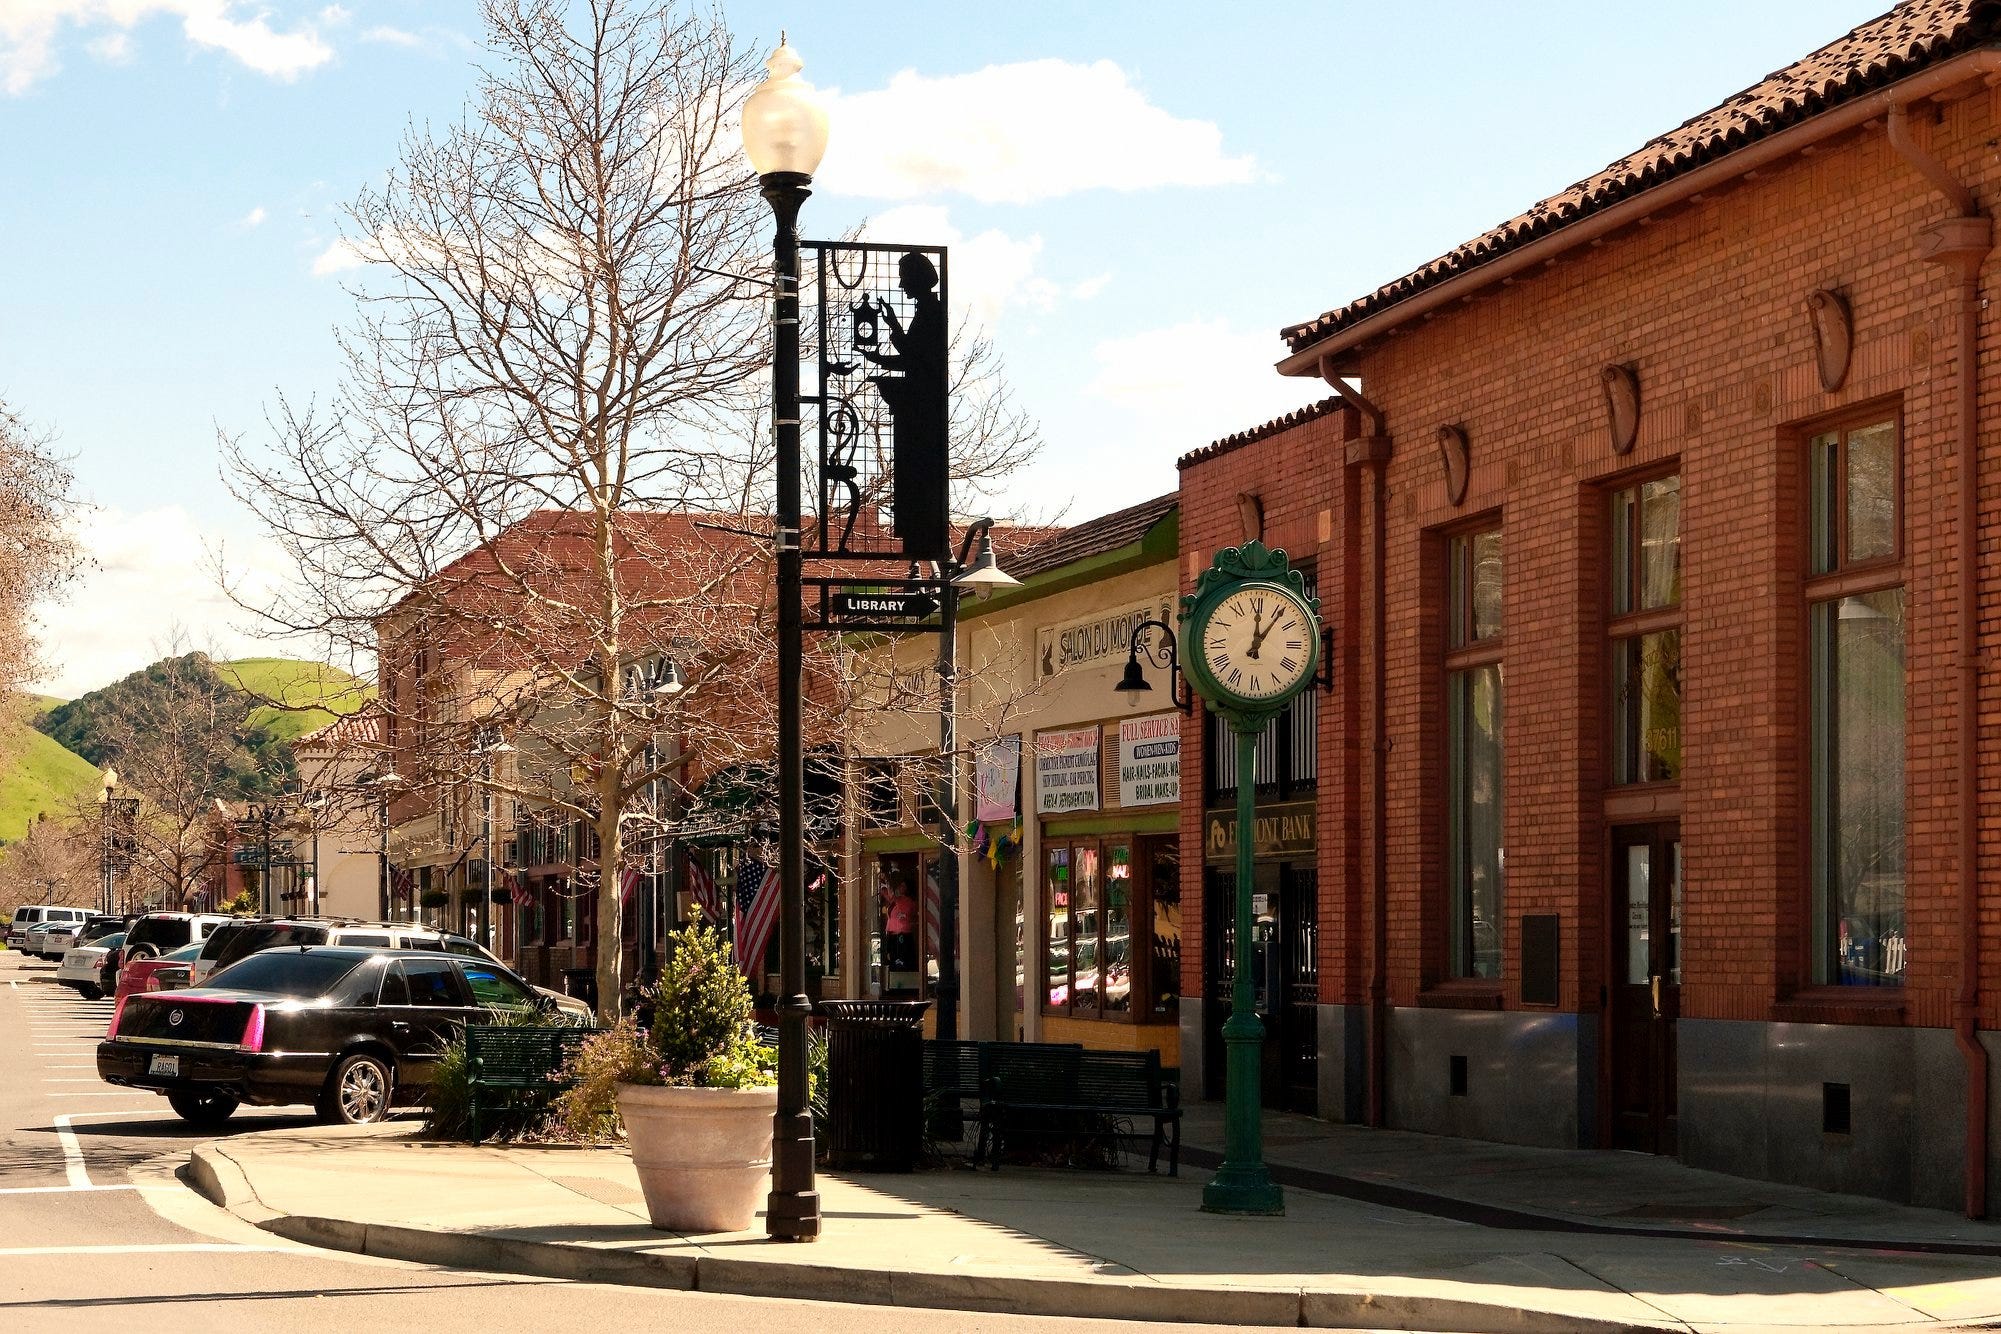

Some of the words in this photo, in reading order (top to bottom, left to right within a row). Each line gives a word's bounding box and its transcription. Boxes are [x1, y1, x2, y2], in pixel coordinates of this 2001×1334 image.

[847, 598, 905, 611] LIBRARY
[1059, 622, 1092, 667] SALON
[1094, 616, 1110, 659] DU
[1110, 606, 1153, 655] MONDE
[1122, 723, 1139, 742] FULL
[1140, 719, 1168, 739] SERVICE
[1645, 726, 1677, 753] 37611
[1135, 783, 1153, 801] BRIDAL
[1282, 815, 1311, 841] BANK
